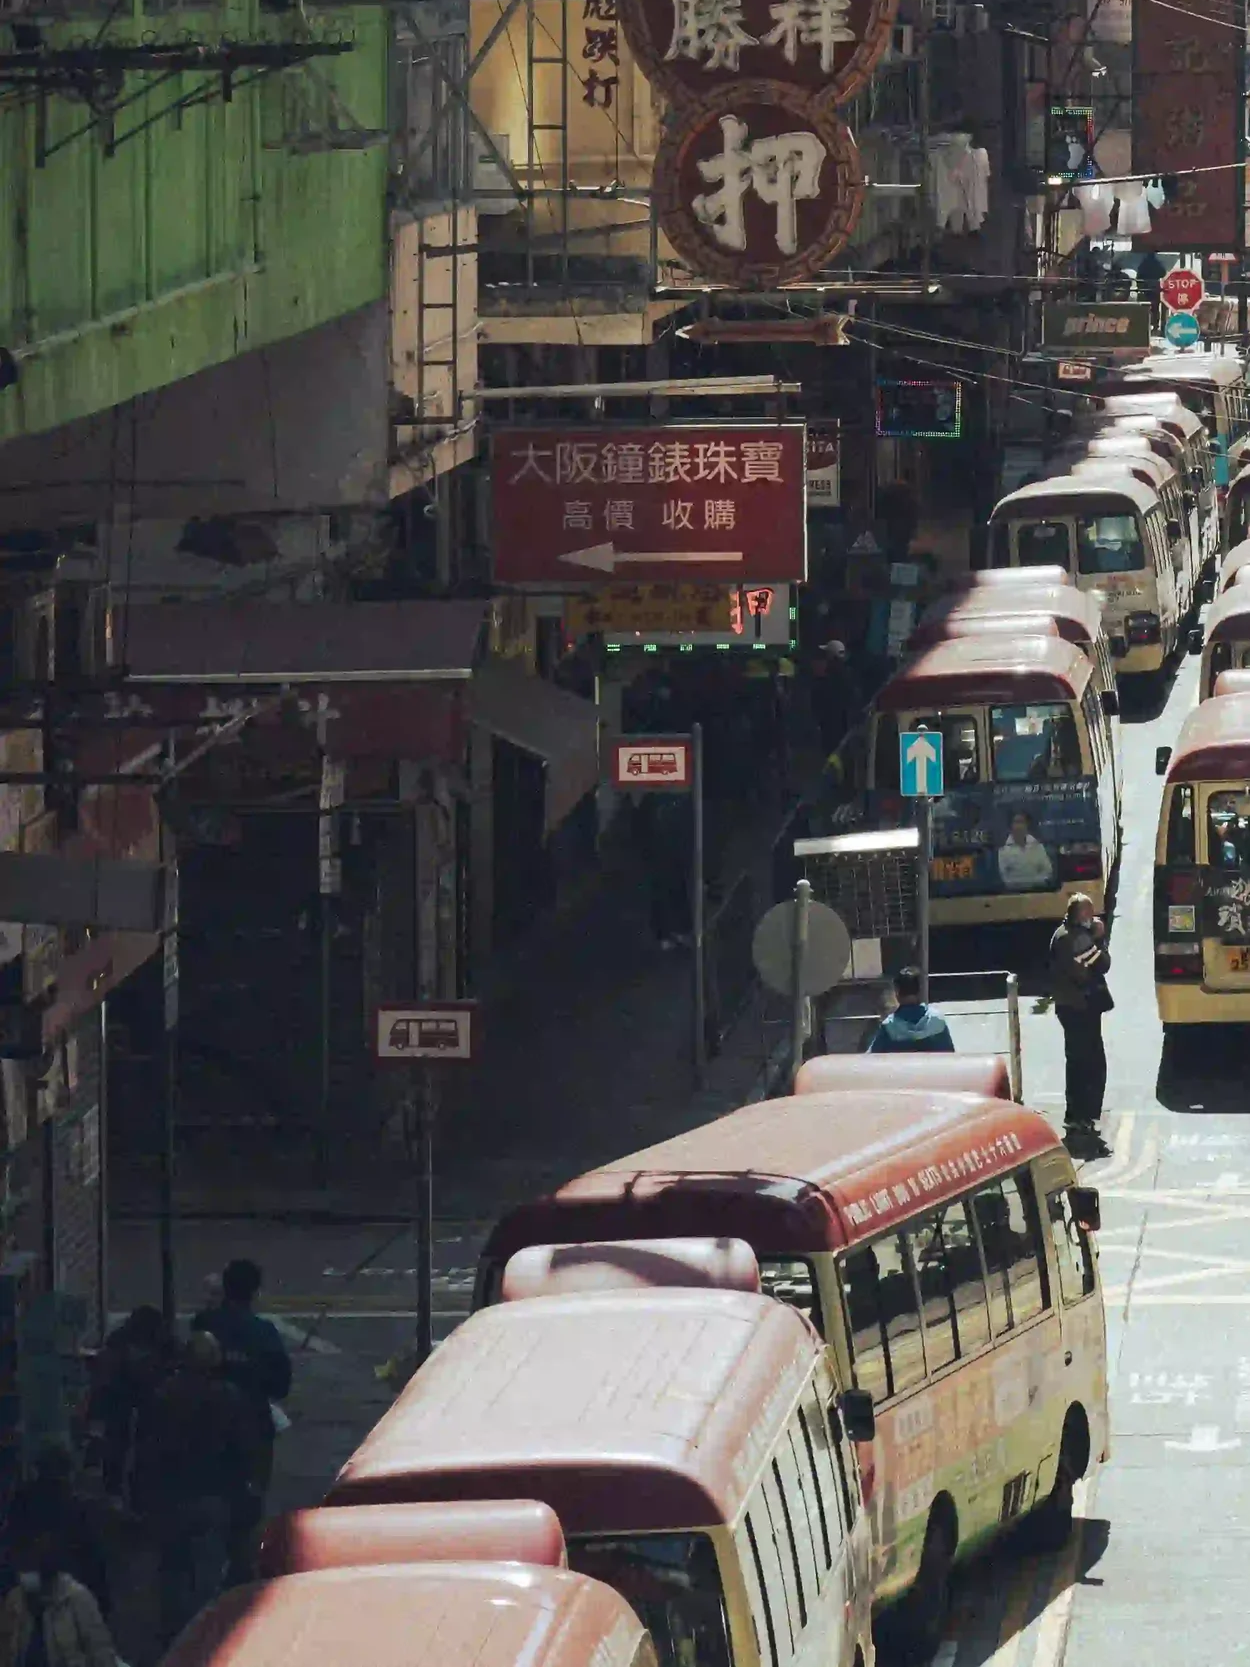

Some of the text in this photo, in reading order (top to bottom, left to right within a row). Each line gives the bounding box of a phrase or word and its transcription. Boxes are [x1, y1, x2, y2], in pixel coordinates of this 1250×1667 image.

[691, 113, 827, 255] 押
[1167, 279, 1197, 289] STOP
[1177, 292, 1190, 306] 停
[1062, 312, 1131, 335] prince
[509, 441, 785, 485] 大阪鐘錶珠寶
[562, 498, 737, 531] 高價 收購
[729, 586, 774, 639] 押
